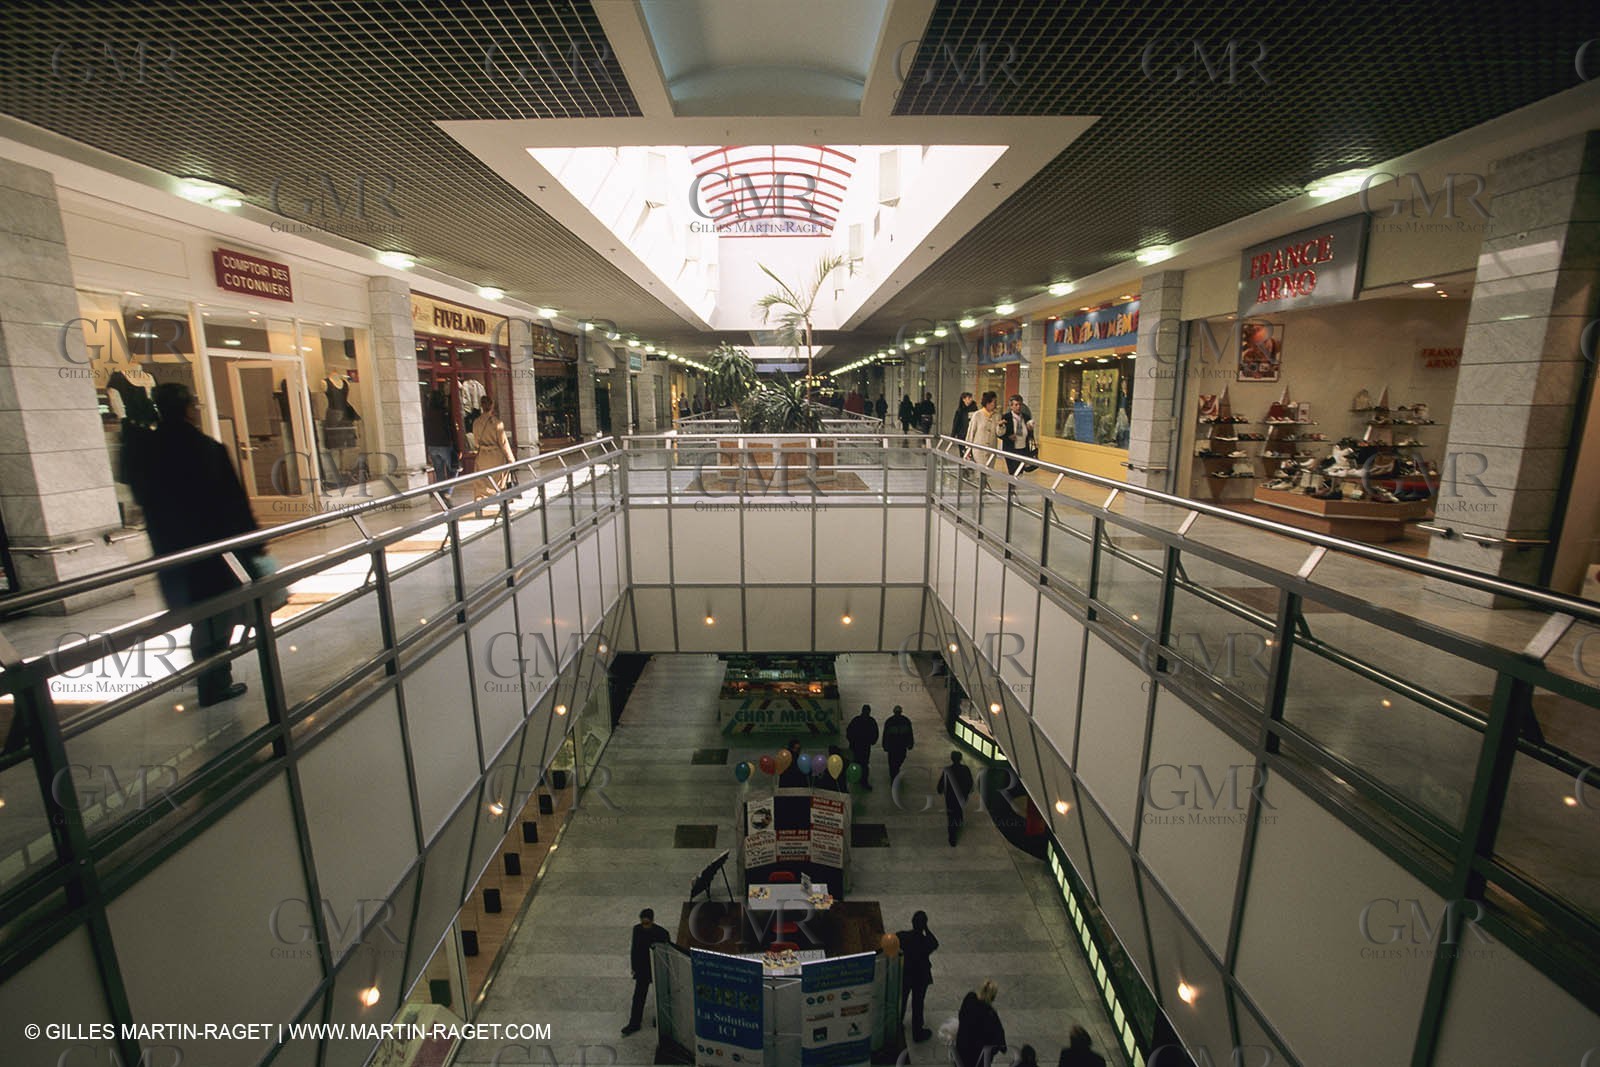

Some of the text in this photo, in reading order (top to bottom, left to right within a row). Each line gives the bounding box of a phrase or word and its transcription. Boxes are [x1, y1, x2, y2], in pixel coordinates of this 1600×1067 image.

[222, 255, 288, 281] COMPTOIR DES
[1250, 234, 1334, 280] FRANCE
[224, 272, 290, 297] COTONNIERS
[1257, 268, 1317, 304] ARNO
[433, 307, 486, 335] FIVELAND
[735, 709, 827, 723] CHAT MALO
[713, 1012, 760, 1031] Solution
